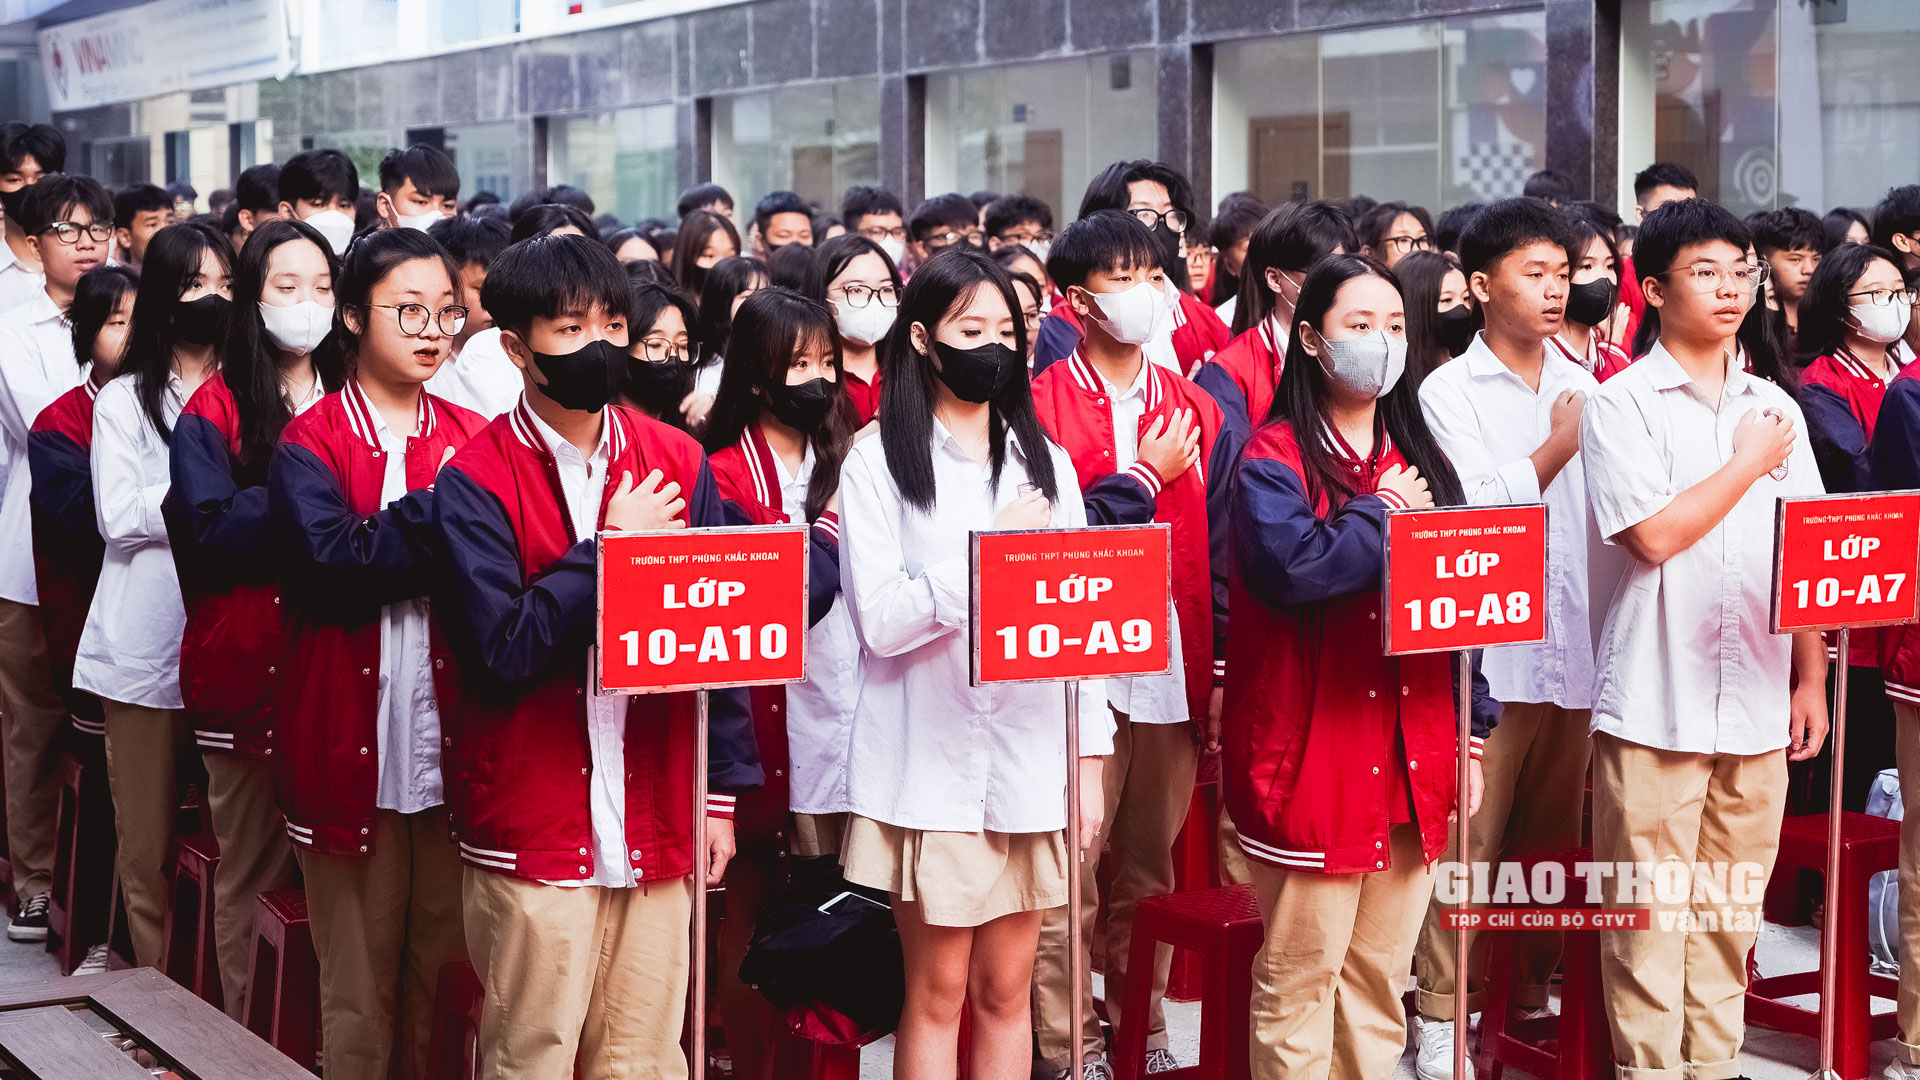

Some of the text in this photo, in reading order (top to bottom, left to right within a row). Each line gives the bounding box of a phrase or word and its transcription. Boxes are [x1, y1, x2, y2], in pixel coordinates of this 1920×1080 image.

[1411, 529, 1438, 540] TRƯỜNG
[1439, 528, 1457, 538] THPT
[1458, 526, 1482, 537] PHÙNG
[1502, 525, 1527, 534] KHOAN
[1827, 514, 1843, 523] THPT
[630, 554, 666, 566] TRƯỜNG
[668, 554, 690, 564] THPT
[691, 552, 722, 564] PHÙNG
[750, 551, 780, 562] KHOAN
[1004, 552, 1038, 563] TRƯỜNG
[1040, 551, 1060, 561] THPT
[1062, 549, 1091, 560] PHÙNG
[1116, 548, 1144, 557] KHOAN
[1823, 534, 1881, 561] LỚP
[1435, 549, 1500, 579] LỚP
[663, 577, 746, 609] LỚP
[1035, 573, 1113, 605] LỚP
[1792, 572, 1906, 609] 10-A7
[1404, 590, 1531, 632] 10-A8
[619, 622, 788, 666] 10-A10
[995, 618, 1153, 660] 10-A9
